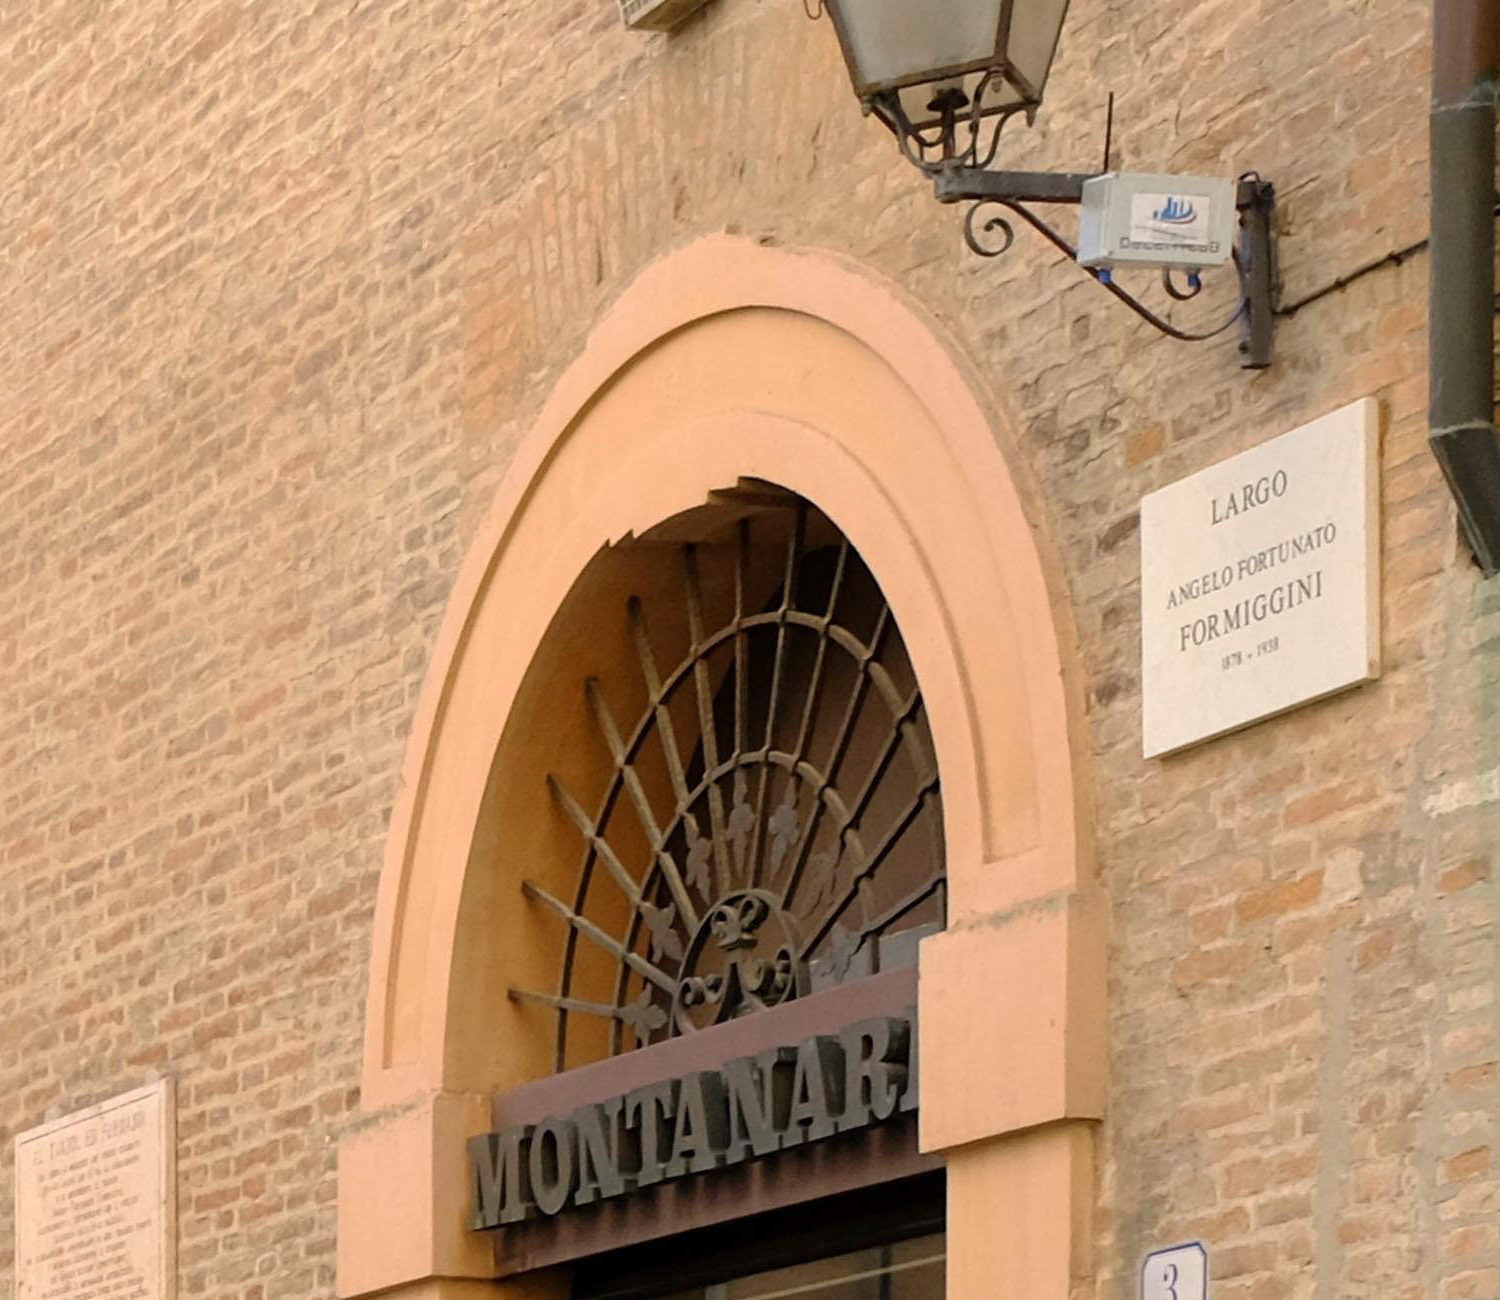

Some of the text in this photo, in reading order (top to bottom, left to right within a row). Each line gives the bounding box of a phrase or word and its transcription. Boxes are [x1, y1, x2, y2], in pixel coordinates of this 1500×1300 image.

[1210, 469, 1289, 526] LARGO
[1166, 522, 1337, 611] ANGELO FORTUNATO
[1180, 571, 1324, 652] FORMIGGINI
